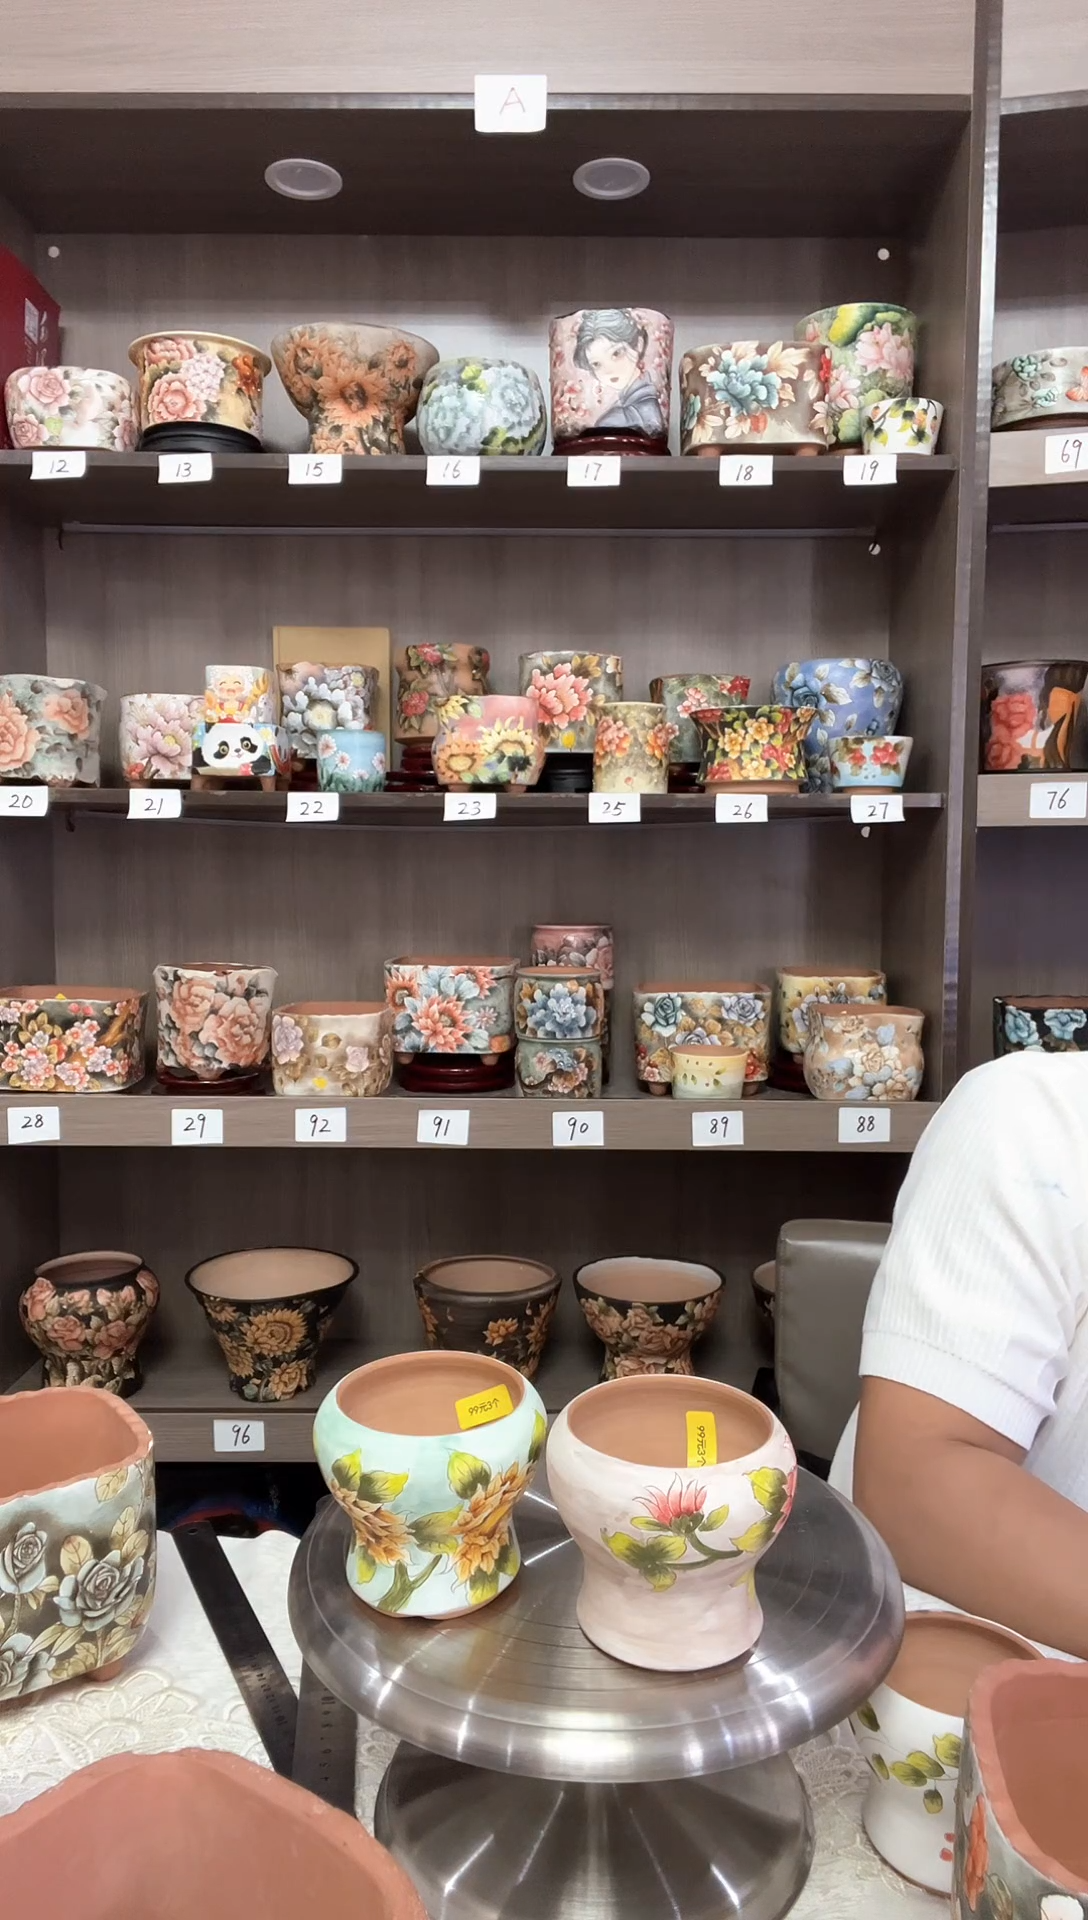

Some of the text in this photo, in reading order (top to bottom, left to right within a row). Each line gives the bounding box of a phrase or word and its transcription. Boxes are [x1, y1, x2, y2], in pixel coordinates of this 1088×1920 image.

[498, 86, 527, 117] A
[1060, 438, 1083, 468] 69
[49, 459, 70, 474] 12
[175, 461, 193, 478] 13
[305, 461, 325, 478] 15
[442, 459, 461, 480] 16
[584, 462, 603, 482] 17
[735, 463, 755, 482] 18
[859, 459, 879, 481] 19
[7, 793, 34, 809] 20
[143, 797, 164, 815] 21
[299, 800, 324, 816] 22
[457, 800, 482, 816] 23
[602, 800, 627, 817] 25
[1046, 787, 1071, 811] 76
[732, 801, 753, 819] 26
[867, 801, 890, 819] 27
[20, 1113, 45, 1130] 28
[182, 1112, 207, 1139] 29
[309, 1113, 332, 1138] 92
[432, 1115, 451, 1139] 91
[567, 1116, 590, 1142] 90
[709, 1115, 730, 1139] 89
[856, 1115, 876, 1134] 88
[467, 1397, 500, 1416] 99元3个
[231, 1424, 251, 1447] 96
